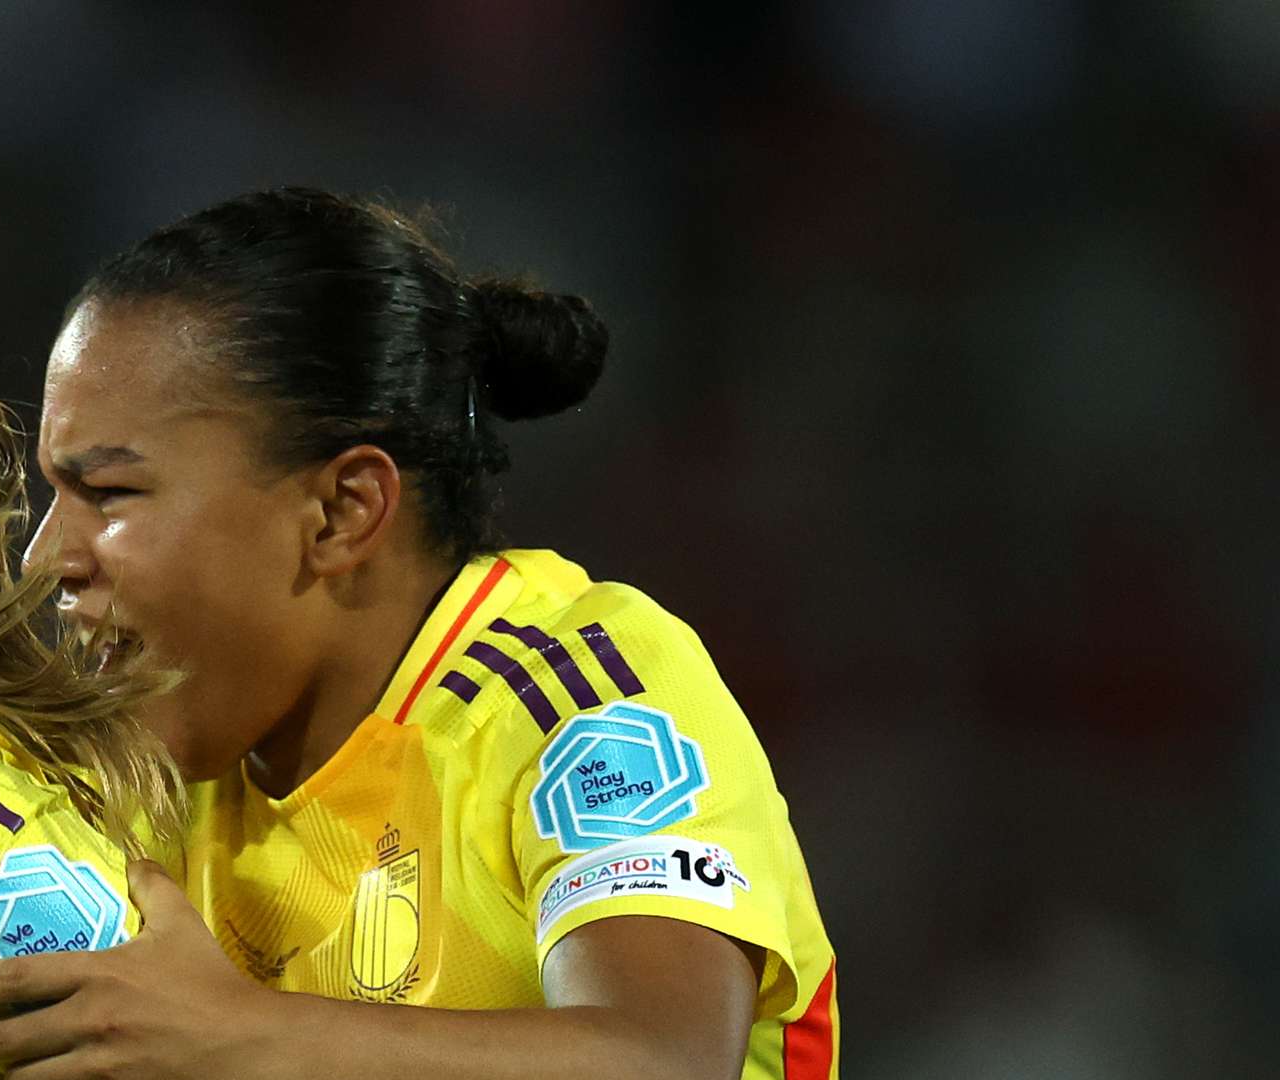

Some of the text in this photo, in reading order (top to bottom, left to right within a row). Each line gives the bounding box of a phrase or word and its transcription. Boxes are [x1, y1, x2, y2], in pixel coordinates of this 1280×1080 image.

[576, 759, 607, 776] We
[581, 770, 625, 794] Play
[585, 780, 654, 809] Strong
[671, 849, 725, 888] 10
[610, 880, 668, 895] for children
[2, 924, 34, 944] We
